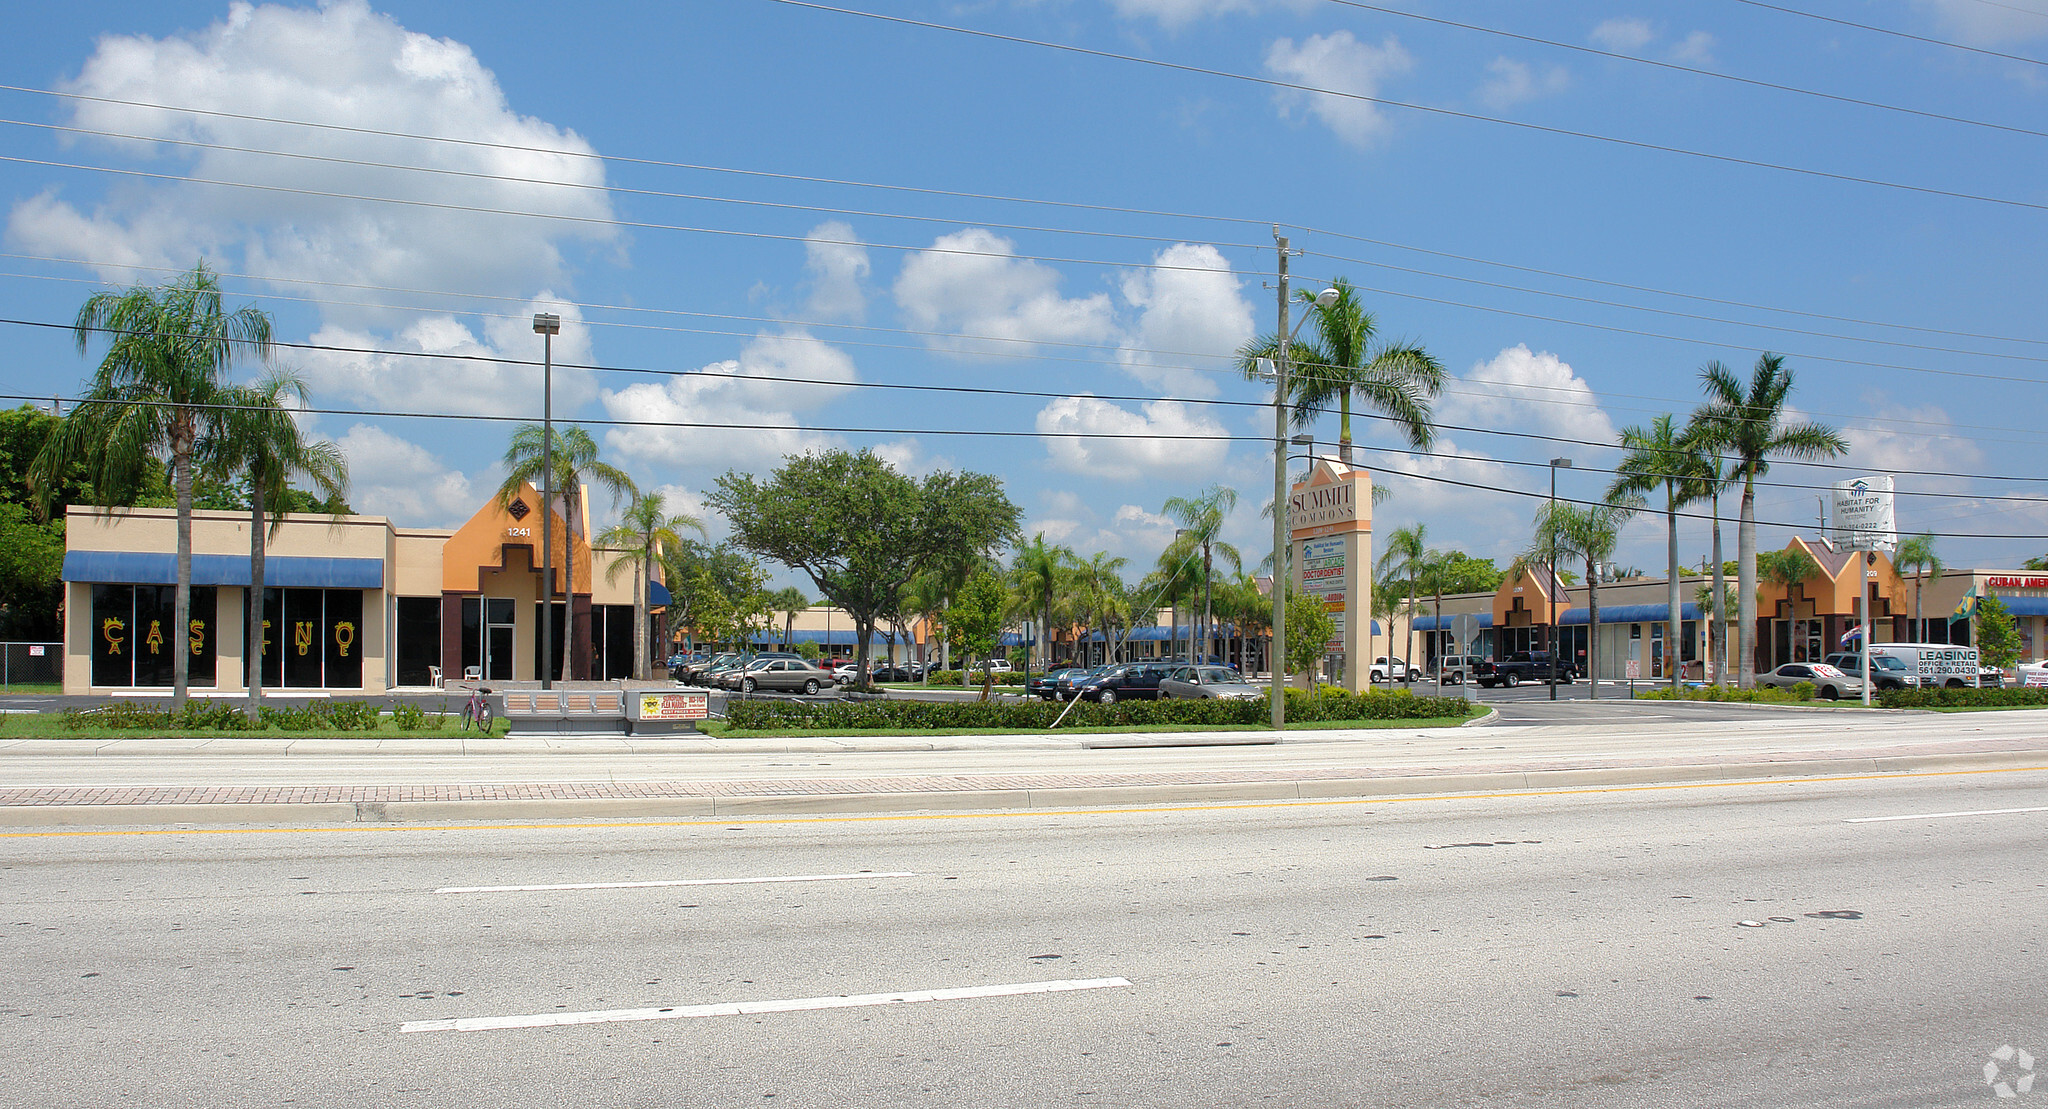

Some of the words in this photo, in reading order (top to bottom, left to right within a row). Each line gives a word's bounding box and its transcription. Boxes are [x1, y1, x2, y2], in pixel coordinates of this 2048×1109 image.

[1292, 484, 1352, 513] SUMMIT
[1836, 498, 1863, 507] HABITAT
[1865, 497, 1880, 505] FOR
[1840, 505, 1875, 514] HUMANITY
[1292, 506, 1353, 526] COMMONS
[508, 527, 531, 537] 1241
[1324, 557, 1344, 567] ARCADE
[1303, 569, 1324, 579] DOCTOR
[1324, 567, 1345, 577] DENTIST
[1988, 577, 2022, 587] CUBAN
[108, 642, 349, 657] ARCDE
[1919, 651, 1977, 660] LEASING
[1918, 667, 1977, 675] 561.290.0430
